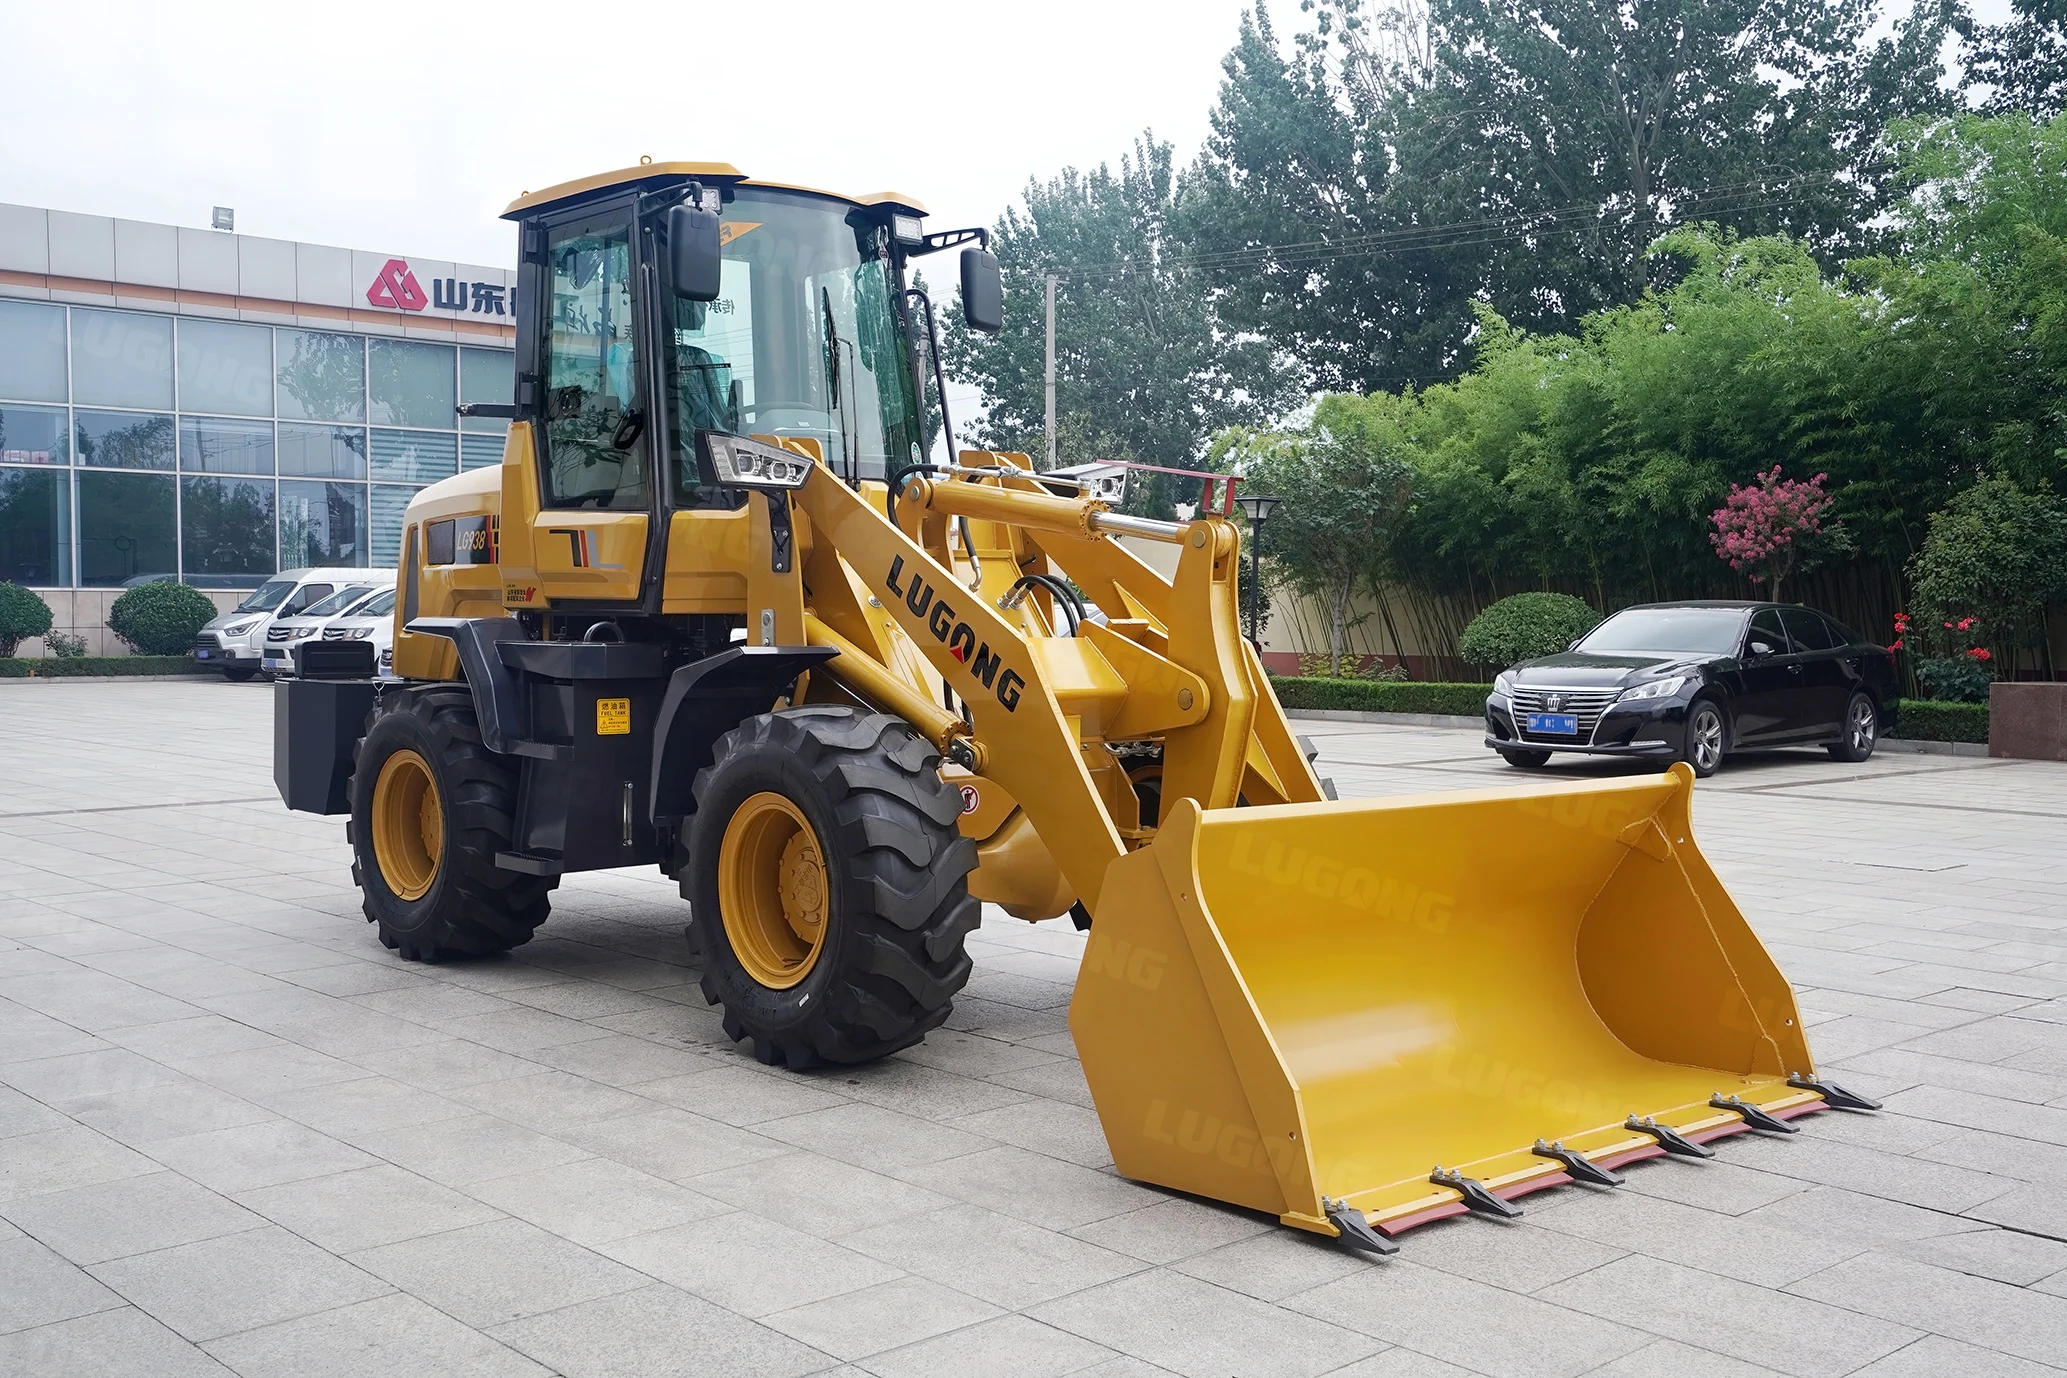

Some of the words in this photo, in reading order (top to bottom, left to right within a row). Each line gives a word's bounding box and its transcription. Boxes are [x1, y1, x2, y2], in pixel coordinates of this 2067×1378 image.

[433, 278, 517, 317] 山东
[456, 530, 486, 550] LG938
[886, 553, 1026, 713] LUGONG
